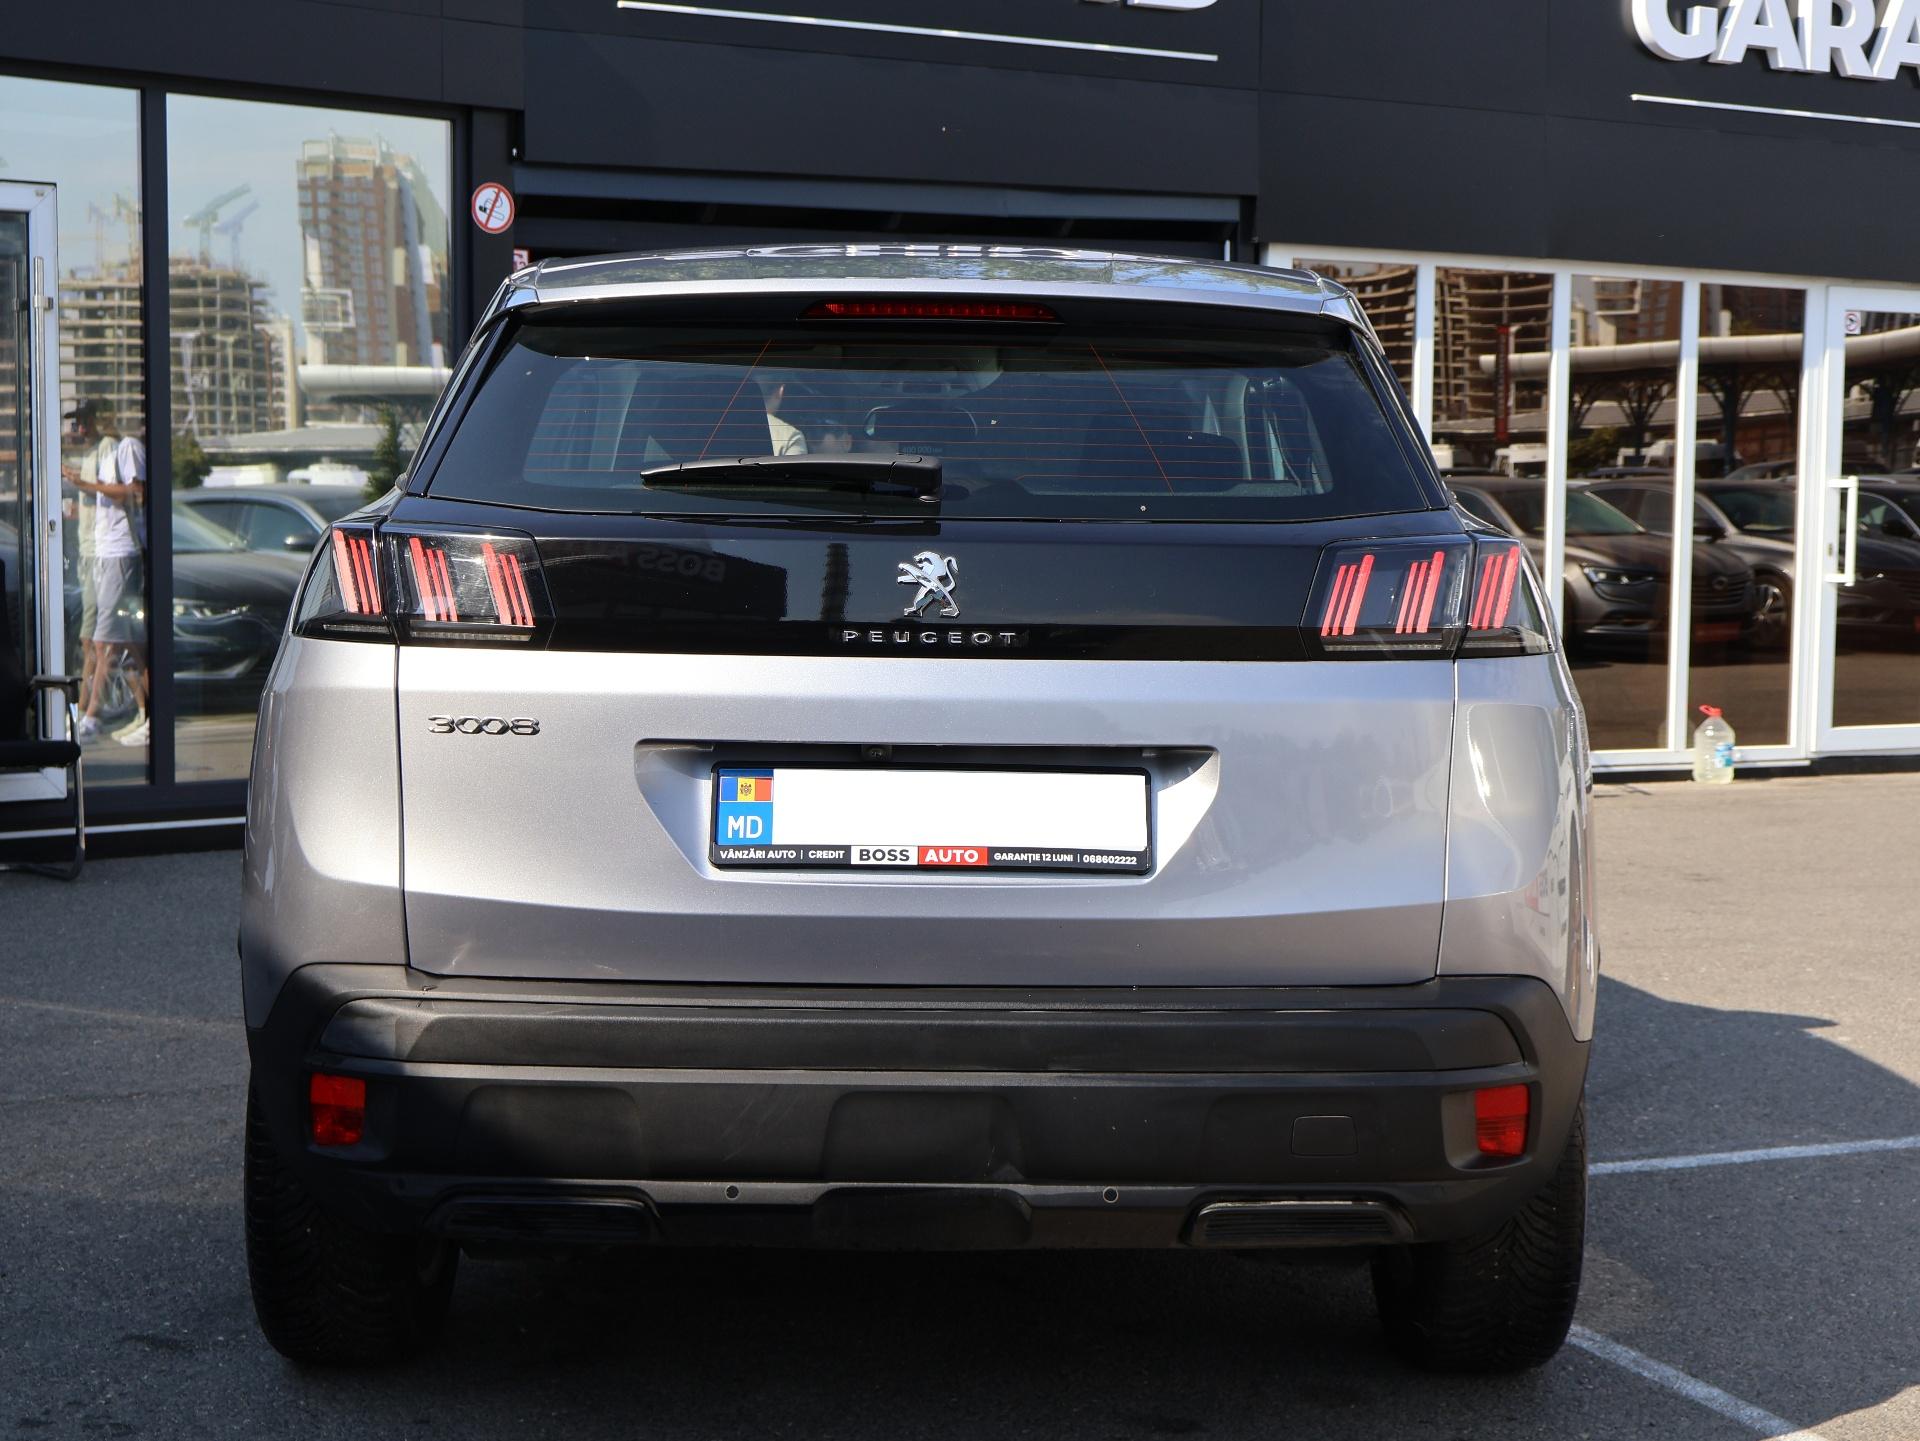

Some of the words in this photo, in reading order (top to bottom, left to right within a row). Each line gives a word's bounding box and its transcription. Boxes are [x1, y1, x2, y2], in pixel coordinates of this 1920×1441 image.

[842, 629, 1017, 645] PEUGEOT
[427, 714, 541, 736] 3008
[727, 815, 764, 839] MD
[719, 848, 766, 860] VÂNZĂRI
[766, 849, 797, 860] AUTO
[808, 850, 846, 860] CREDIT
[858, 848, 911, 862] BOSS
[923, 848, 980, 863] AUTO
[1041, 853, 1052, 862] 12
[1052, 854, 1074, 863] LUNI
[1082, 854, 1138, 866] 068602222
